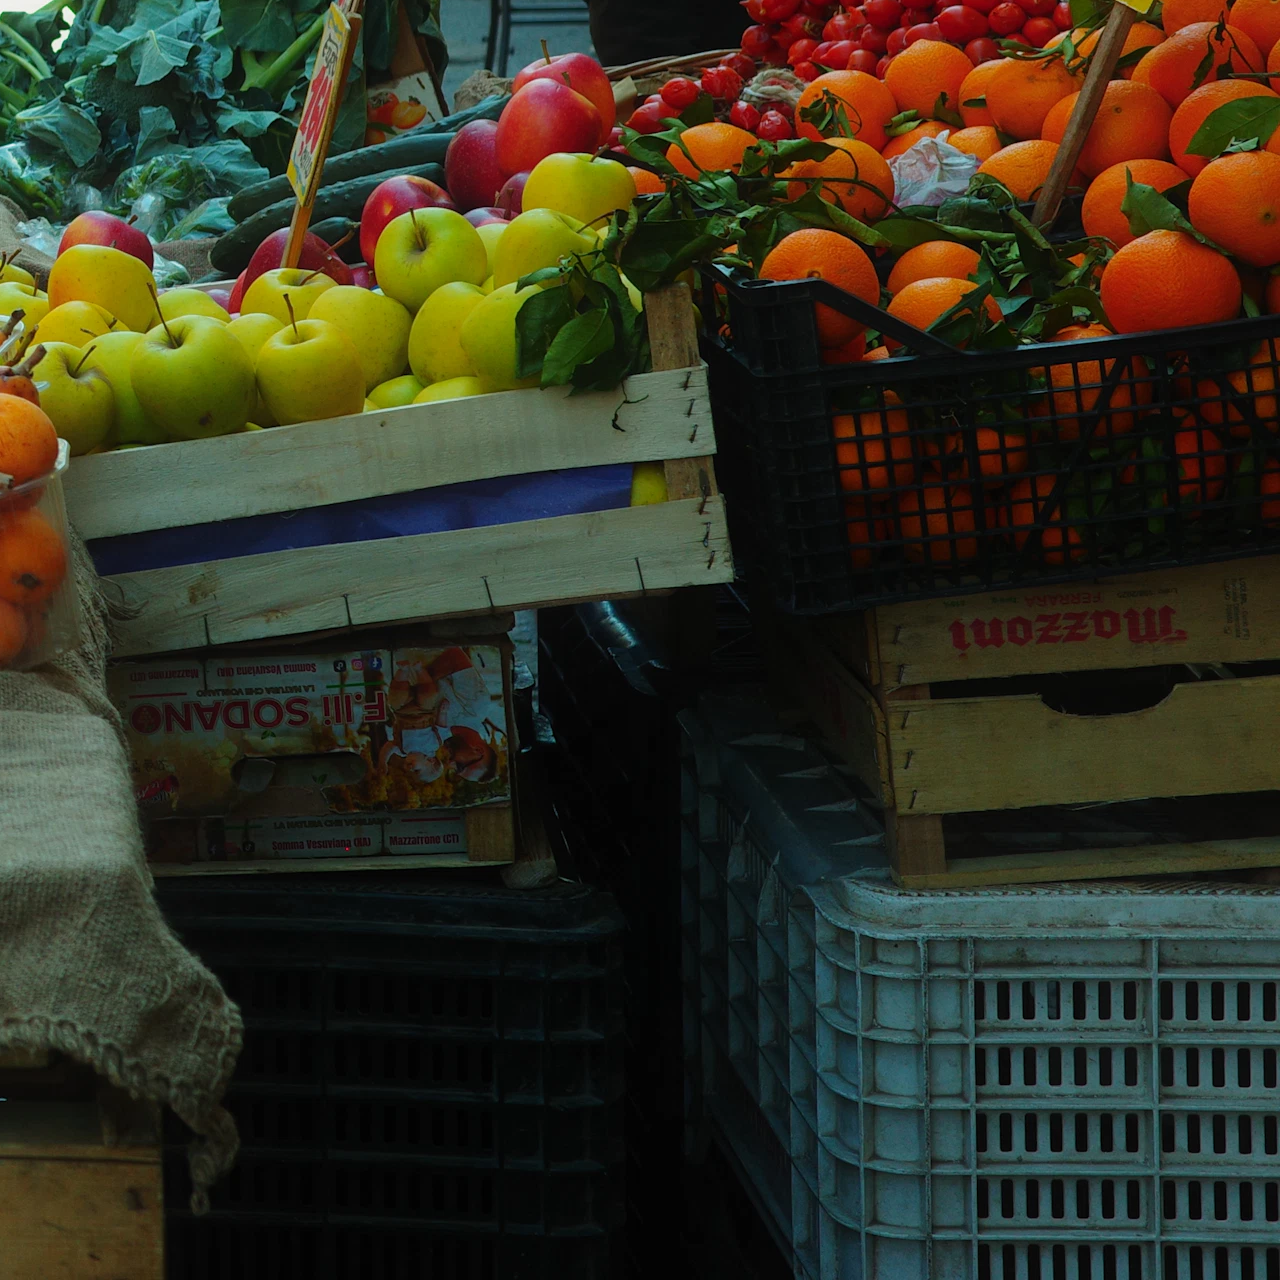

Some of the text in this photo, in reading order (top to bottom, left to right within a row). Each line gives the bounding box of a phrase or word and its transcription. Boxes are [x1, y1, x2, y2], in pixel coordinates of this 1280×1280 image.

[1024, 591, 1103, 608] FERRARA
[947, 605, 1188, 661] Mazzoni
[236, 664, 282, 676] Vesuviana
[284, 663, 316, 675] Somma
[196, 687, 243, 697] VOGLIAMO
[244, 687, 263, 696] CHE
[264, 685, 302, 695] NATURA
[322, 691, 387, 726] F.lli
[286, 820, 323, 829] NATURA
[324, 820, 343, 828] CHE
[344, 818, 392, 826] VOGLIAMO
[272, 840, 304, 851] Somma
[306, 839, 352, 850] Vesuviana
[389, 834, 459, 846] Mazzarrone (CT)
